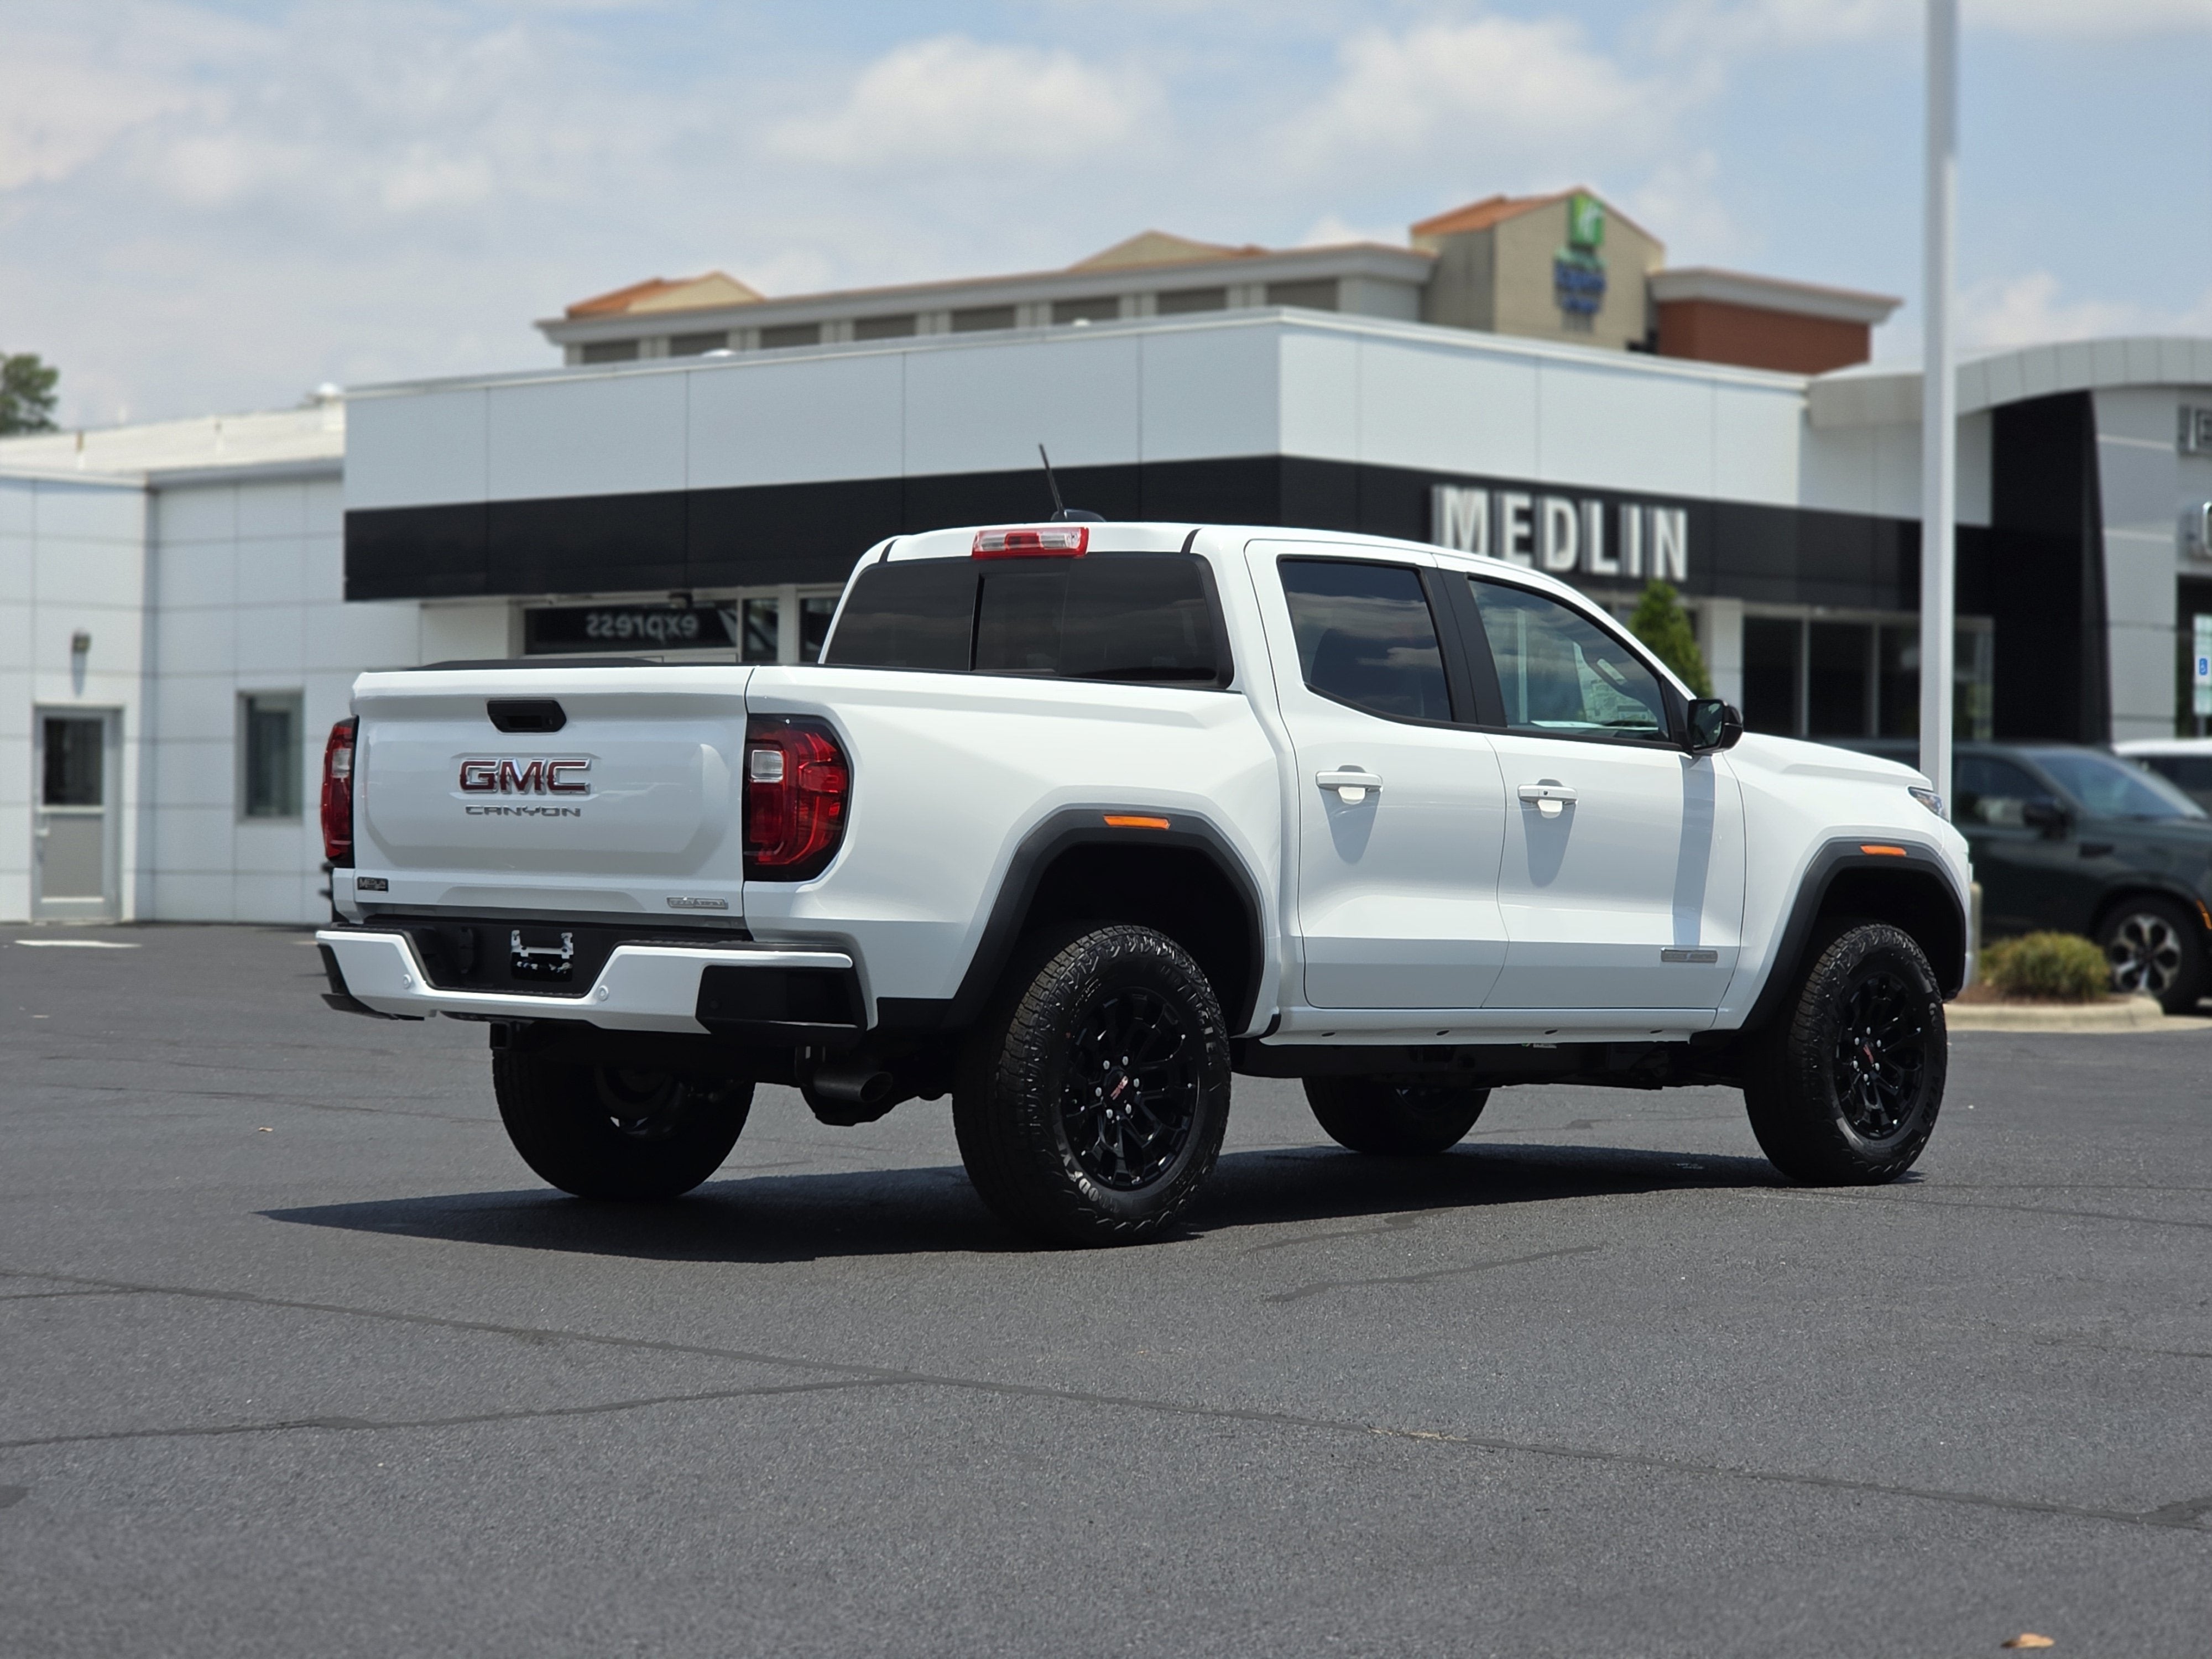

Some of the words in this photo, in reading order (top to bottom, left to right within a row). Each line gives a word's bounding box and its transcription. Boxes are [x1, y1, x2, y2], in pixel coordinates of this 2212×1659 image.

[1432, 485, 1687, 581] MEDLIN
[459, 758, 591, 795] GMC
[465, 805, 581, 817] CANYON
